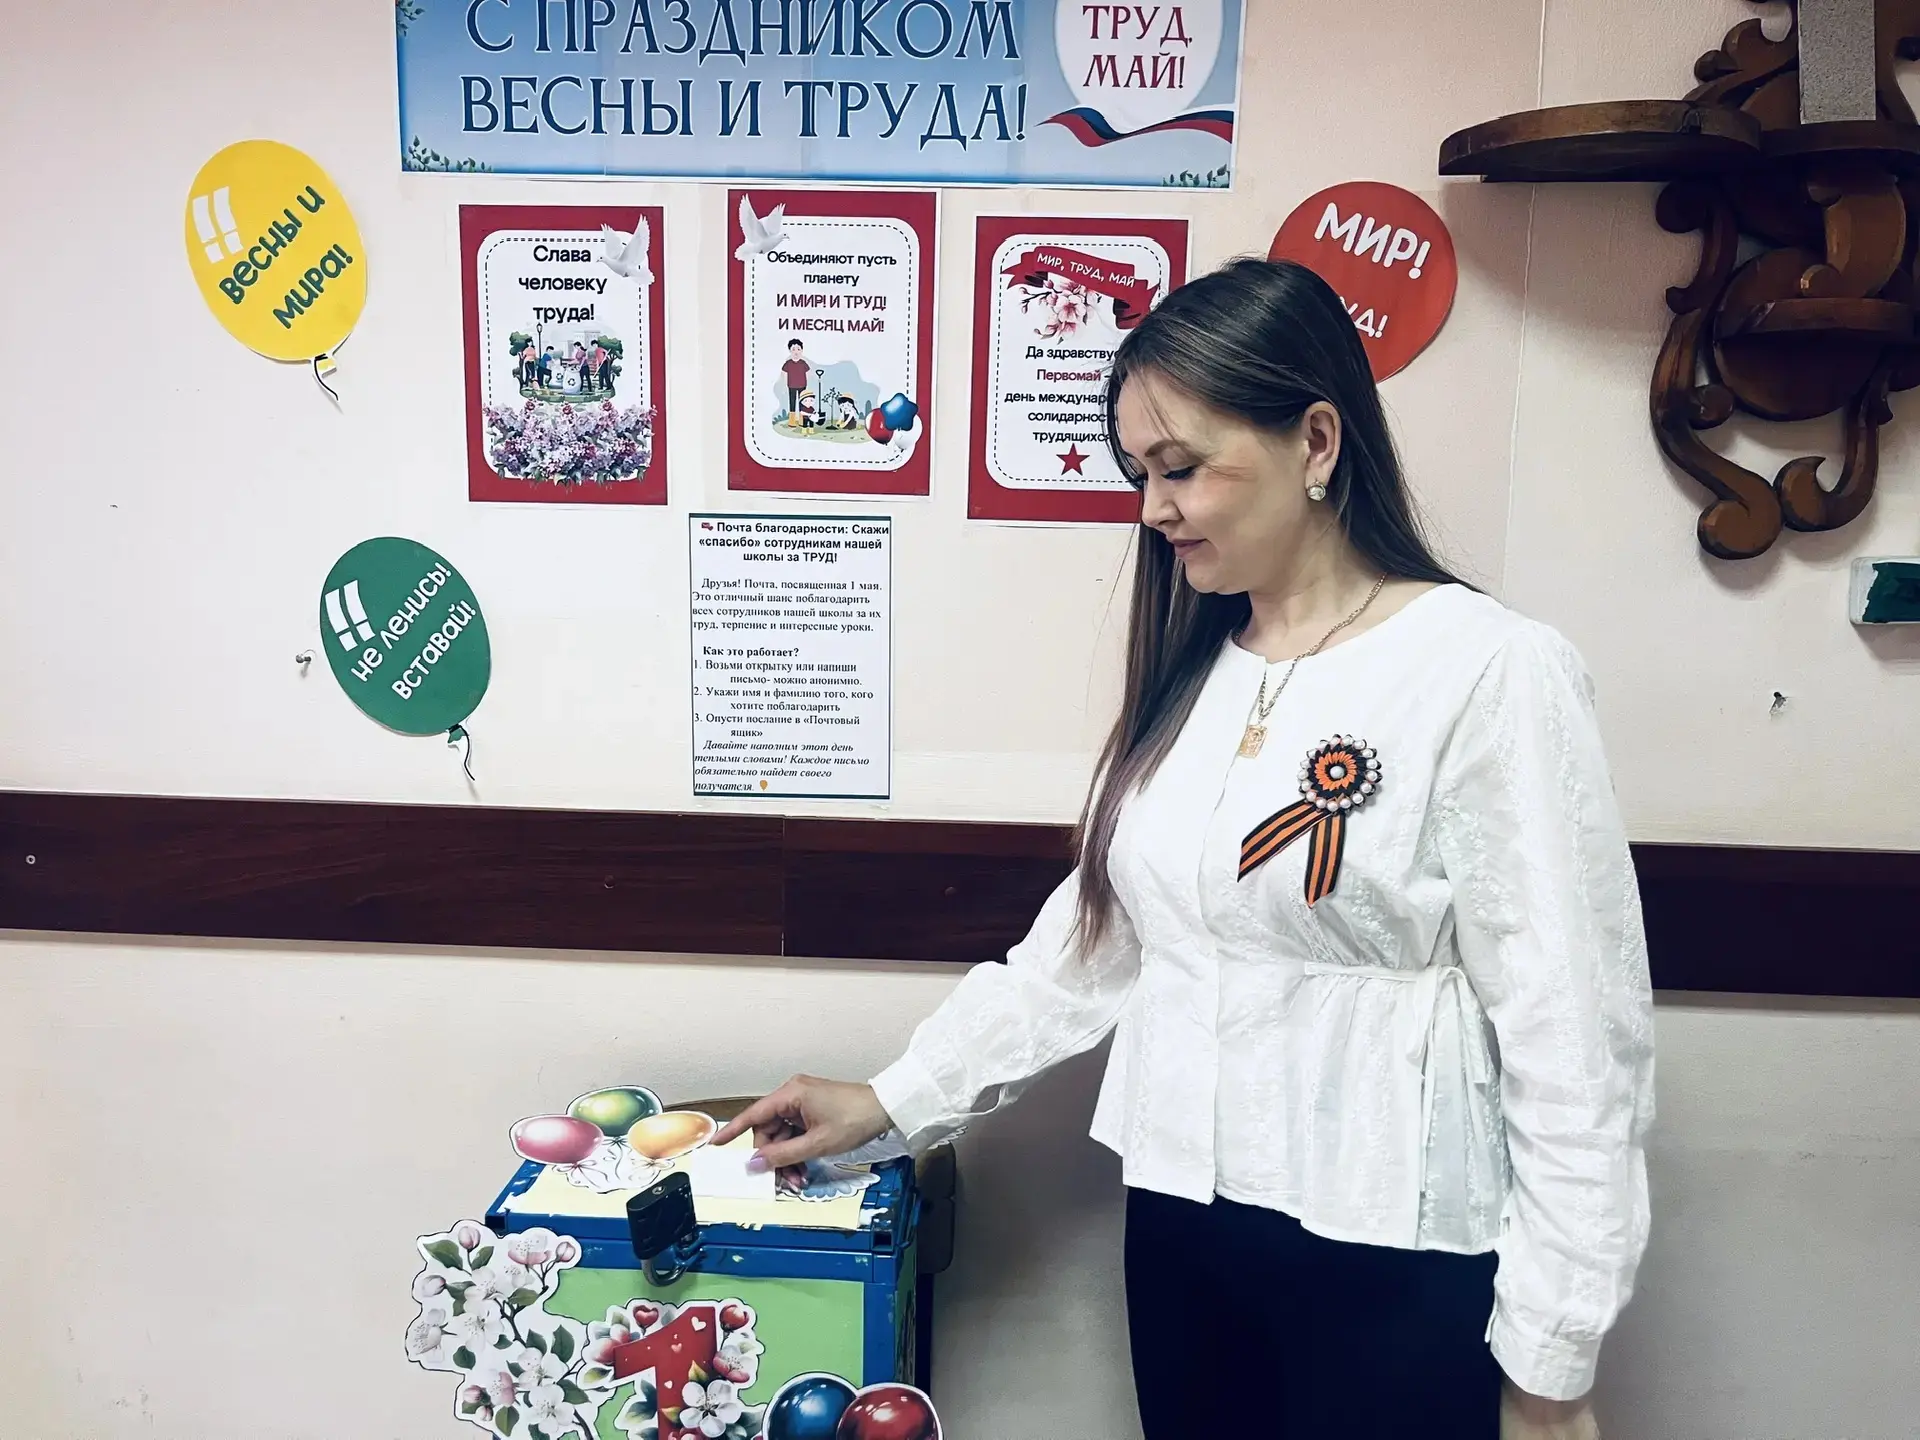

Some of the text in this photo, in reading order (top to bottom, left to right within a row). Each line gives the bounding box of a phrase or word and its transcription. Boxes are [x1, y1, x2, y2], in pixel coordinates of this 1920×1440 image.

[466, 0, 1020, 66] С ПРАЗДНИКОМ
[1082, 6, 1193, 48] ТРУД,
[1082, 52, 1185, 89] МАЙ!
[460, 75, 1028, 153] ВЕСНЫ И ТРУДА!
[1314, 202, 1431, 279] МИР!
[533, 245, 591, 262] Слава
[767, 251, 897, 267] Объединяют пусть
[1037, 253, 1135, 287] МИР, ТРУД, МАЙ
[519, 276, 607, 294] человеку
[804, 274, 859, 286] планету
[777, 294, 886, 310] И МИР! И ТРУД!
[533, 304, 595, 323] труда!
[779, 318, 884, 333] И МЕСЯЦ МАЙ!
[1026, 346, 1043, 360] Да
[1037, 369, 1101, 382] Первомай
[1005, 393, 1035, 403] день
[717, 523, 889, 535] Почта благодарности: Скажи
[699, 537, 881, 549] «спасибо» сотрудникам нашей
[744, 553, 783, 561] школы
[803, 552, 837, 564] ТРУД!
[701, 578, 882, 591] Друзья! Почта, посвященная 1 мая.
[692, 592, 870, 605] Это отличный шанс поблагодарить
[716, 608, 780, 618] сотрудников
[783, 608, 815, 617] нашей
[819, 609, 853, 618] школы
[722, 621, 767, 632] терпение
[780, 622, 838, 632] интересные
[841, 623, 874, 633] уроки.
[703, 646, 799, 658] Как это работает?
[694, 660, 856, 673] 1. Возьми открытку или напиши
[730, 676, 862, 686] письмо- можно анонимно.
[694, 687, 702, 696] 2.
[705, 687, 739, 697] Укажи
[773, 688, 820, 699] фамилию
[823, 691, 848, 699] того,
[730, 702, 840, 712] хотите поблагодарить
[694, 713, 702, 722] 3.
[706, 715, 743, 724] Опусти
[746, 716, 792, 724] послание
[804, 716, 860, 725] «Почтовый
[731, 729, 763, 737] ящик»
[703, 740, 853, 752] Давайте наполним этот день
[694, 754, 869, 766] теплыми словами! Каждое письмо
[694, 767, 832, 778] обязательно найдет своего
